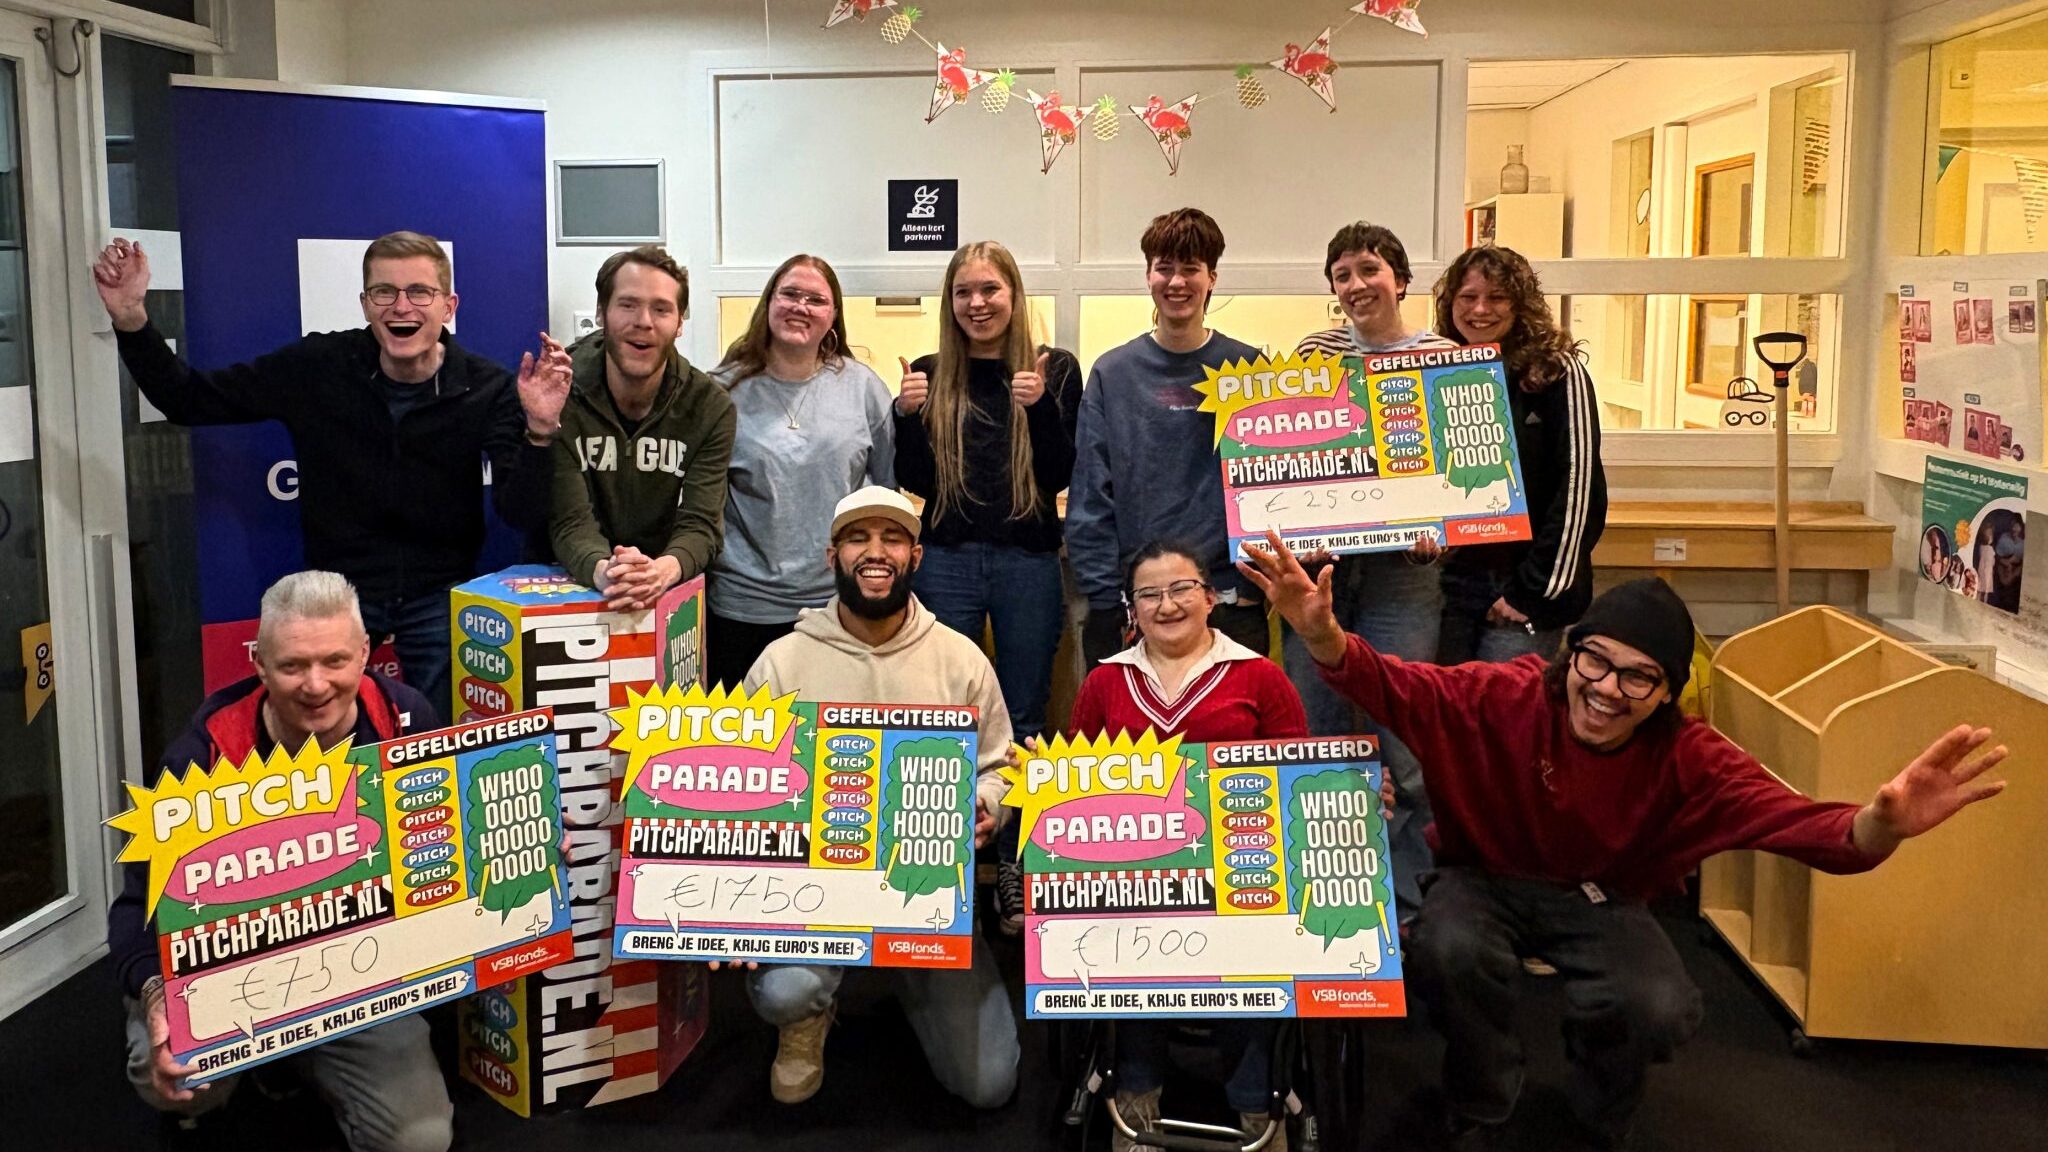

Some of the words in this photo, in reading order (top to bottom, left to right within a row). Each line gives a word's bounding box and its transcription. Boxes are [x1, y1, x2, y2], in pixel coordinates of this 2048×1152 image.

[1368, 347, 1497, 372] GEFELICITEERD
[1218, 366, 1331, 402] PITCH
[1379, 379, 1411, 389] PITCH
[1441, 383, 1494, 406] WHOO
[1381, 392, 1412, 402] PITCH
[1236, 408, 1351, 437] PARADE
[1384, 406, 1415, 416] PITCH
[1447, 404, 1495, 426] OOOO
[1386, 419, 1418, 429] PITCH
[1444, 423, 1505, 448] HOOOO
[1387, 432, 1420, 443] PITCH
[1389, 445, 1422, 456] PITCH
[1454, 445, 1502, 468] OOOO
[1228, 452, 1374, 484] PITCHPARADE.NL
[1391, 459, 1423, 470] PITCH
[1329, 535, 1359, 548] KRIJG
[1363, 532, 1400, 544] EURO'S
[464, 612, 506, 640] PITCH
[465, 647, 506, 676] PITCH
[465, 683, 506, 712] PITCH
[638, 705, 776, 743] PITCH
[822, 707, 974, 728] GEFELICITEERD
[386, 715, 548, 764] GEFELICITEERD
[831, 738, 869, 750] PITCH
[830, 756, 867, 768] PITCH
[1213, 740, 1373, 763] GEFELICITEERD
[400, 769, 443, 789] PITCH
[650, 764, 790, 793] PARADE
[829, 775, 867, 786] PITCH
[900, 756, 961, 784] WHOO
[1026, 752, 1164, 795] PITCH
[478, 764, 544, 805] WHOO
[1226, 777, 1265, 789] PITCH
[152, 764, 333, 843] PITCH
[402, 788, 444, 807] PITCH
[828, 793, 865, 804] PITCH
[902, 783, 957, 810] OOOO
[1226, 795, 1265, 808] PITCH
[1301, 790, 1367, 819] WHOO
[404, 808, 446, 828] PITCH
[485, 793, 543, 830] OOOO
[827, 811, 865, 823] PITCH
[1227, 816, 1268, 828] PITCH
[826, 829, 864, 841] PITCH
[893, 811, 963, 838] HOOOO
[1045, 813, 1187, 844] PARADE
[1307, 819, 1366, 848] OOOO
[407, 827, 448, 846] PITCH
[479, 817, 552, 861] HOOOO
[629, 825, 804, 857] PITCHPARADE.NL
[1229, 833, 1268, 846] PITCH
[184, 823, 361, 895] PARADE
[407, 846, 450, 865] PITCH
[825, 847, 862, 859] PITCH
[900, 839, 955, 866] OOOO
[1230, 853, 1270, 865] PITCH
[1301, 848, 1377, 878] HOOOO
[409, 862, 452, 883] PITCH
[489, 846, 547, 885] OOOO
[1232, 872, 1272, 885] PITCH
[411, 882, 454, 902] PITCH
[1031, 877, 1209, 910] PITCHPARADE.NL
[1233, 892, 1273, 905] PITCH
[1312, 878, 1372, 907] OOOO
[169, 887, 388, 972] PITCHPARADE.NL
[632, 935, 674, 950] BRENG
[677, 937, 694, 950] JE
[697, 938, 729, 953] IDEE,
[733, 939, 771, 954] KRIJG
[774, 940, 819, 954] EURO'S
[823, 941, 854, 955] MEE!
[1045, 995, 1086, 1009] BRENG
[1091, 994, 1107, 1009] JE
[1110, 994, 1144, 1010] IDEE,
[1147, 994, 1186, 1008] KRIJG
[1191, 993, 1238, 1008] EURO'S
[1242, 993, 1276, 1007] MEE!
[197, 1044, 251, 1073] BRENG
[256, 1035, 276, 1055] JE
[280, 1024, 317, 1048] IDEE,
[322, 1010, 366, 1034] KRIJG
[370, 992, 421, 1021] EURO'S
[424, 977, 457, 1002] MEE!
[472, 1051, 511, 1091] PITCH
